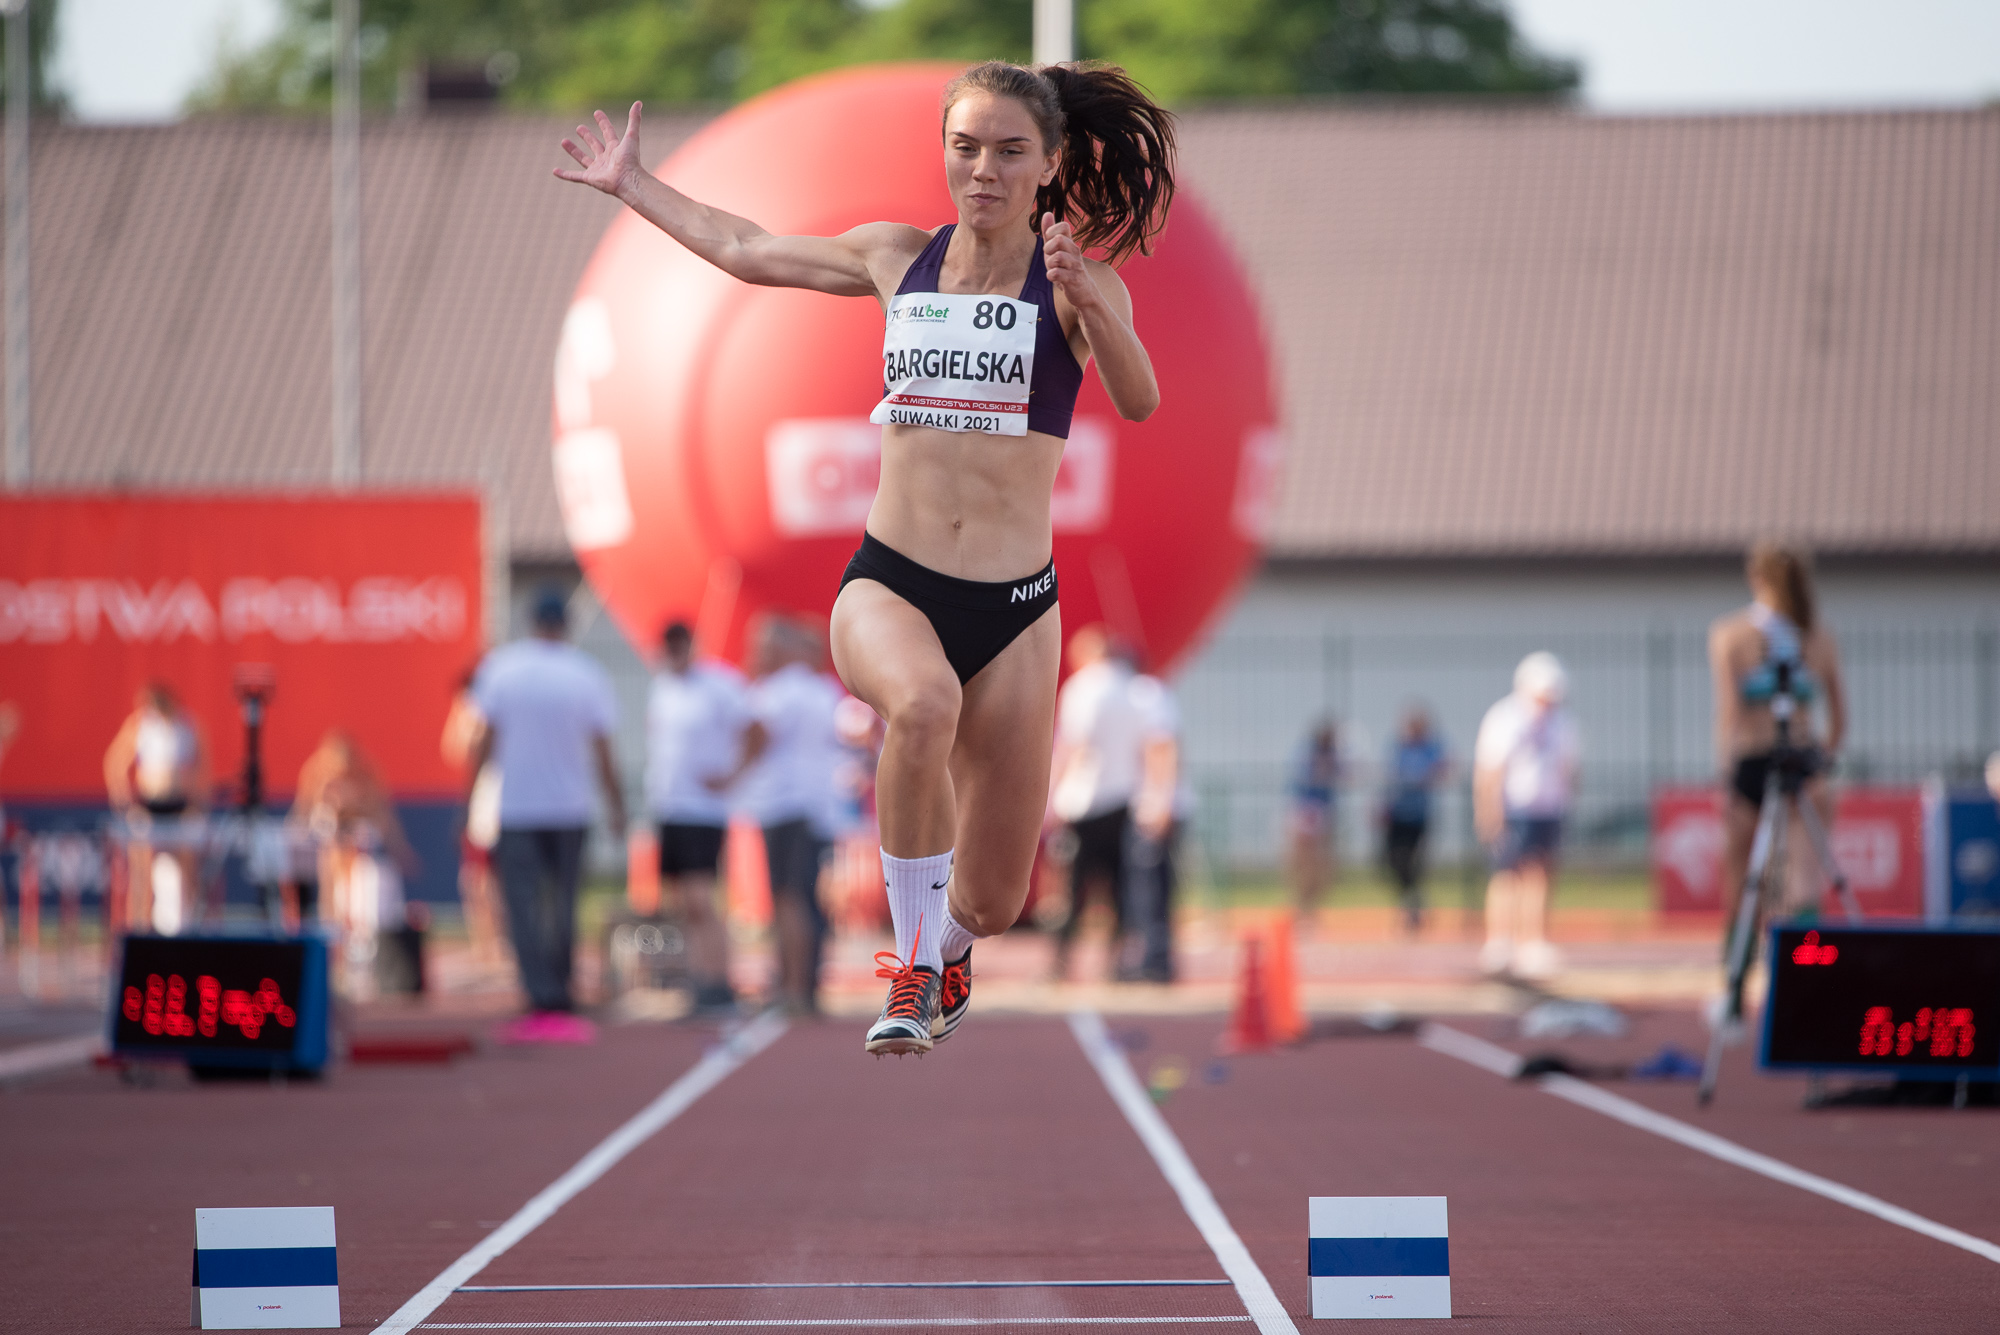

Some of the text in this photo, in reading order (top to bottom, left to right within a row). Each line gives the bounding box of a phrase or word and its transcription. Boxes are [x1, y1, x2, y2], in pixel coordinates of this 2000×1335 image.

[891, 304, 949, 321] TOTALbet
[972, 300, 1017, 331] 80
[887, 348, 1025, 385] BARGIELSKA
[909, 397, 971, 409] MISTRZOSTWA
[972, 402, 1003, 410] POLSKI
[1004, 404, 1023, 412] U23
[889, 409, 1000, 432] SUWAŁKI 2021
